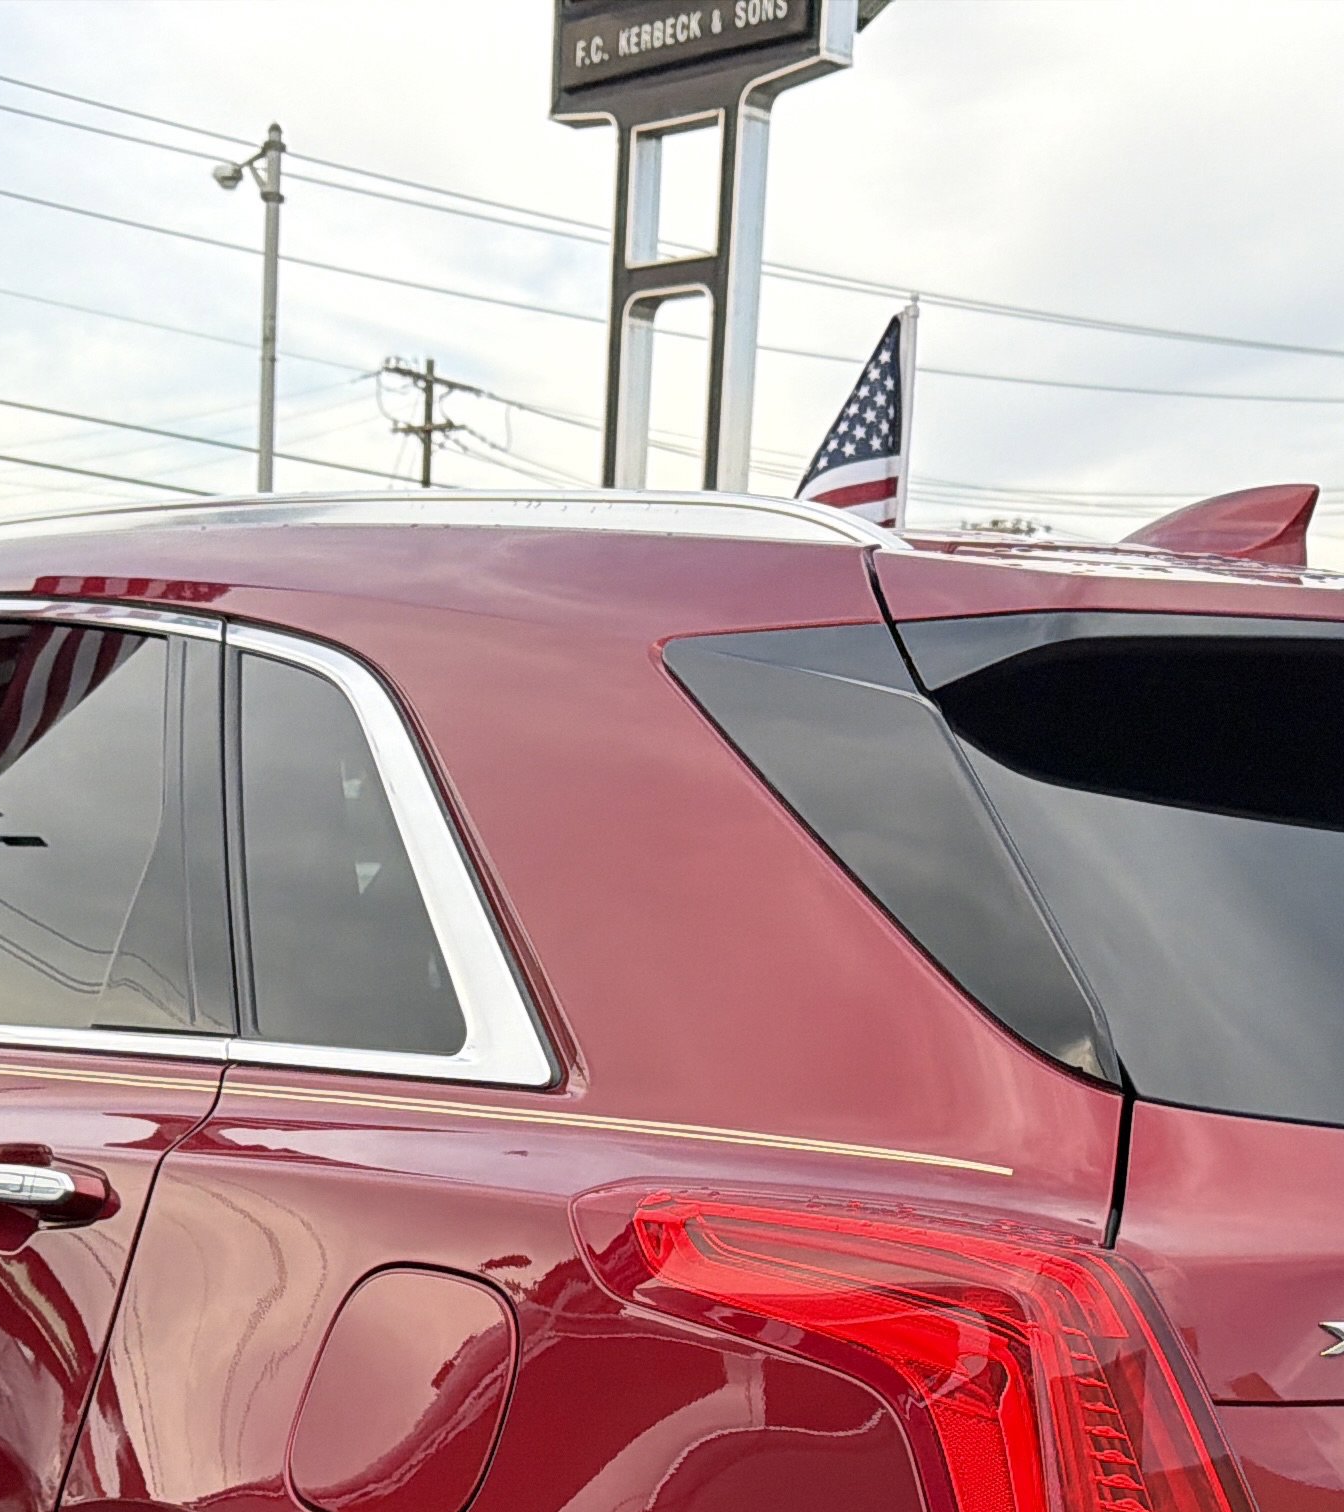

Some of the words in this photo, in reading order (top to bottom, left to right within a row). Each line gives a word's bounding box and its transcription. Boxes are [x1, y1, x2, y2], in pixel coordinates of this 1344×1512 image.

[575, 36, 609, 67] F.C.
[618, 11, 702, 56] KERBECK
[711, 9, 722, 34] &
[734, 0, 788, 29] SONS
